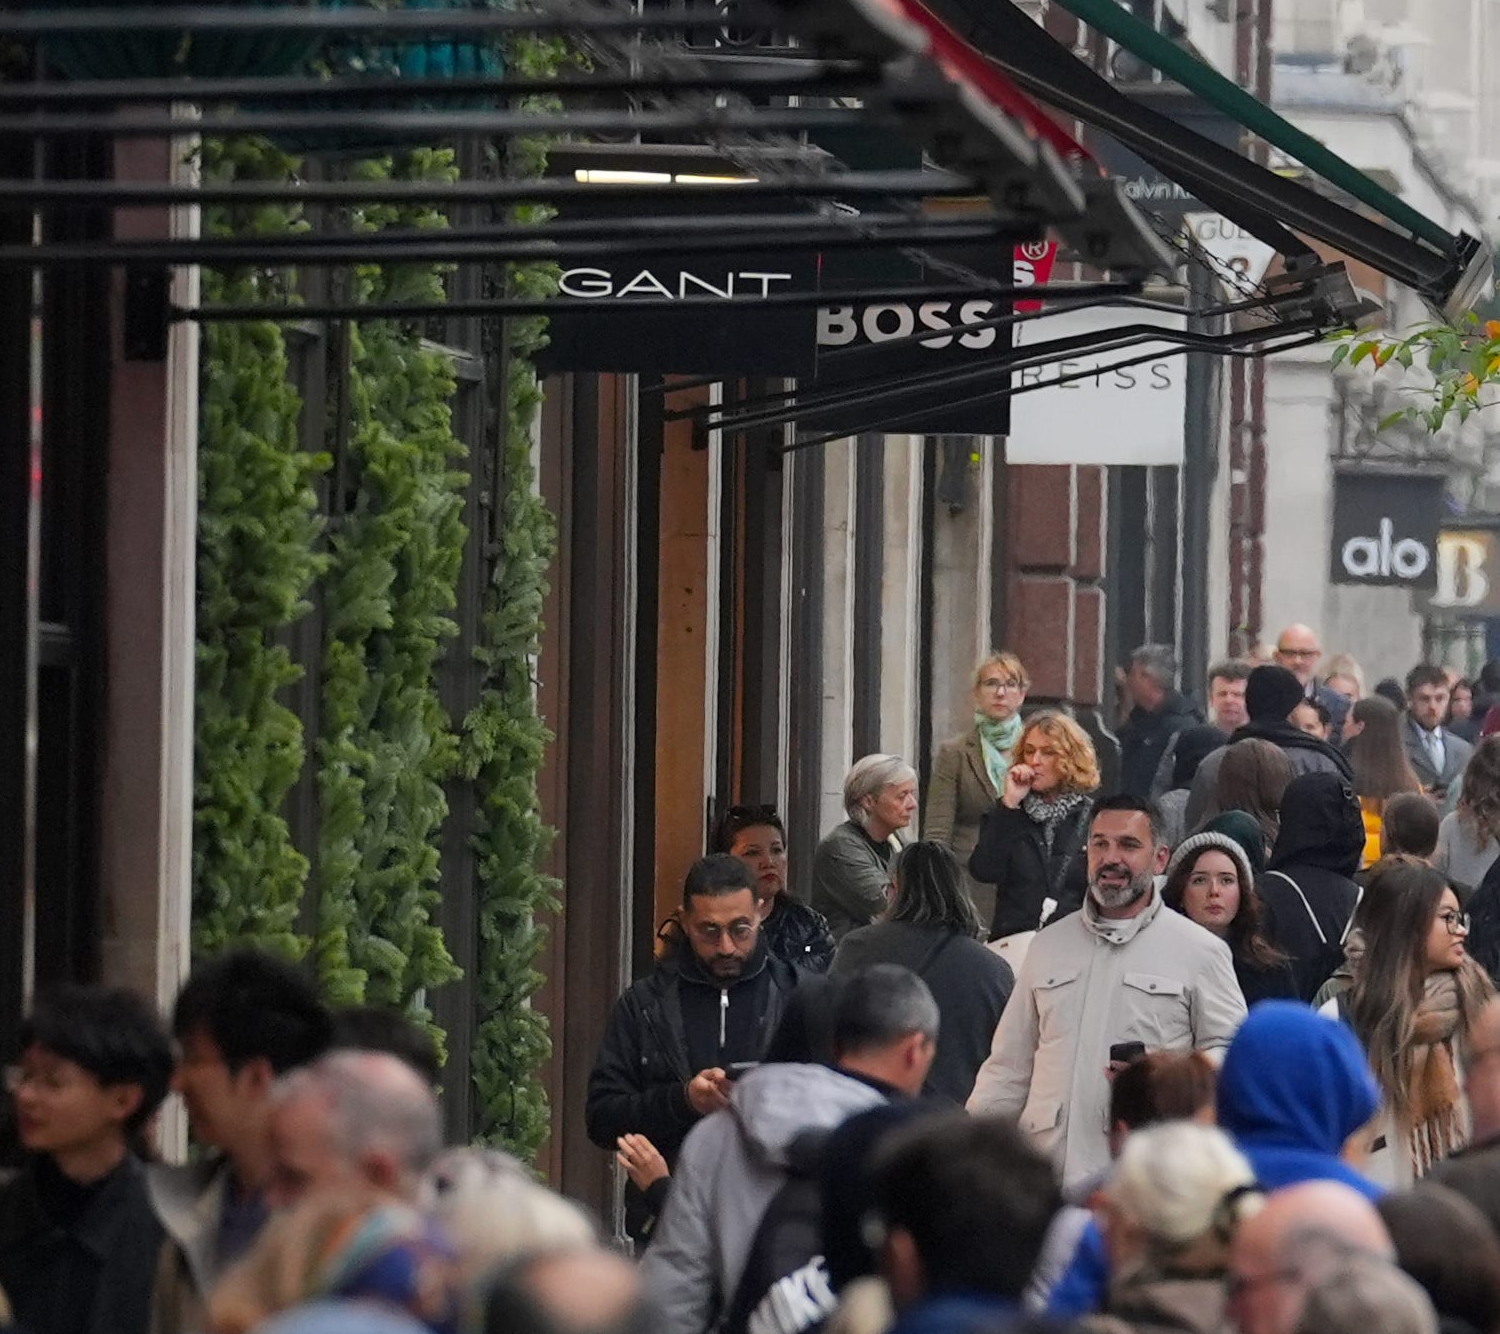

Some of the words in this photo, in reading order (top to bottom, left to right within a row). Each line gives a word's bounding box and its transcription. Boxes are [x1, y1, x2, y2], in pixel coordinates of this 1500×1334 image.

[558, 267, 792, 300] GANT
[816, 300, 996, 350] BOSS
[1020, 363, 1171, 389] REISS
[1342, 517, 1430, 579] alo
